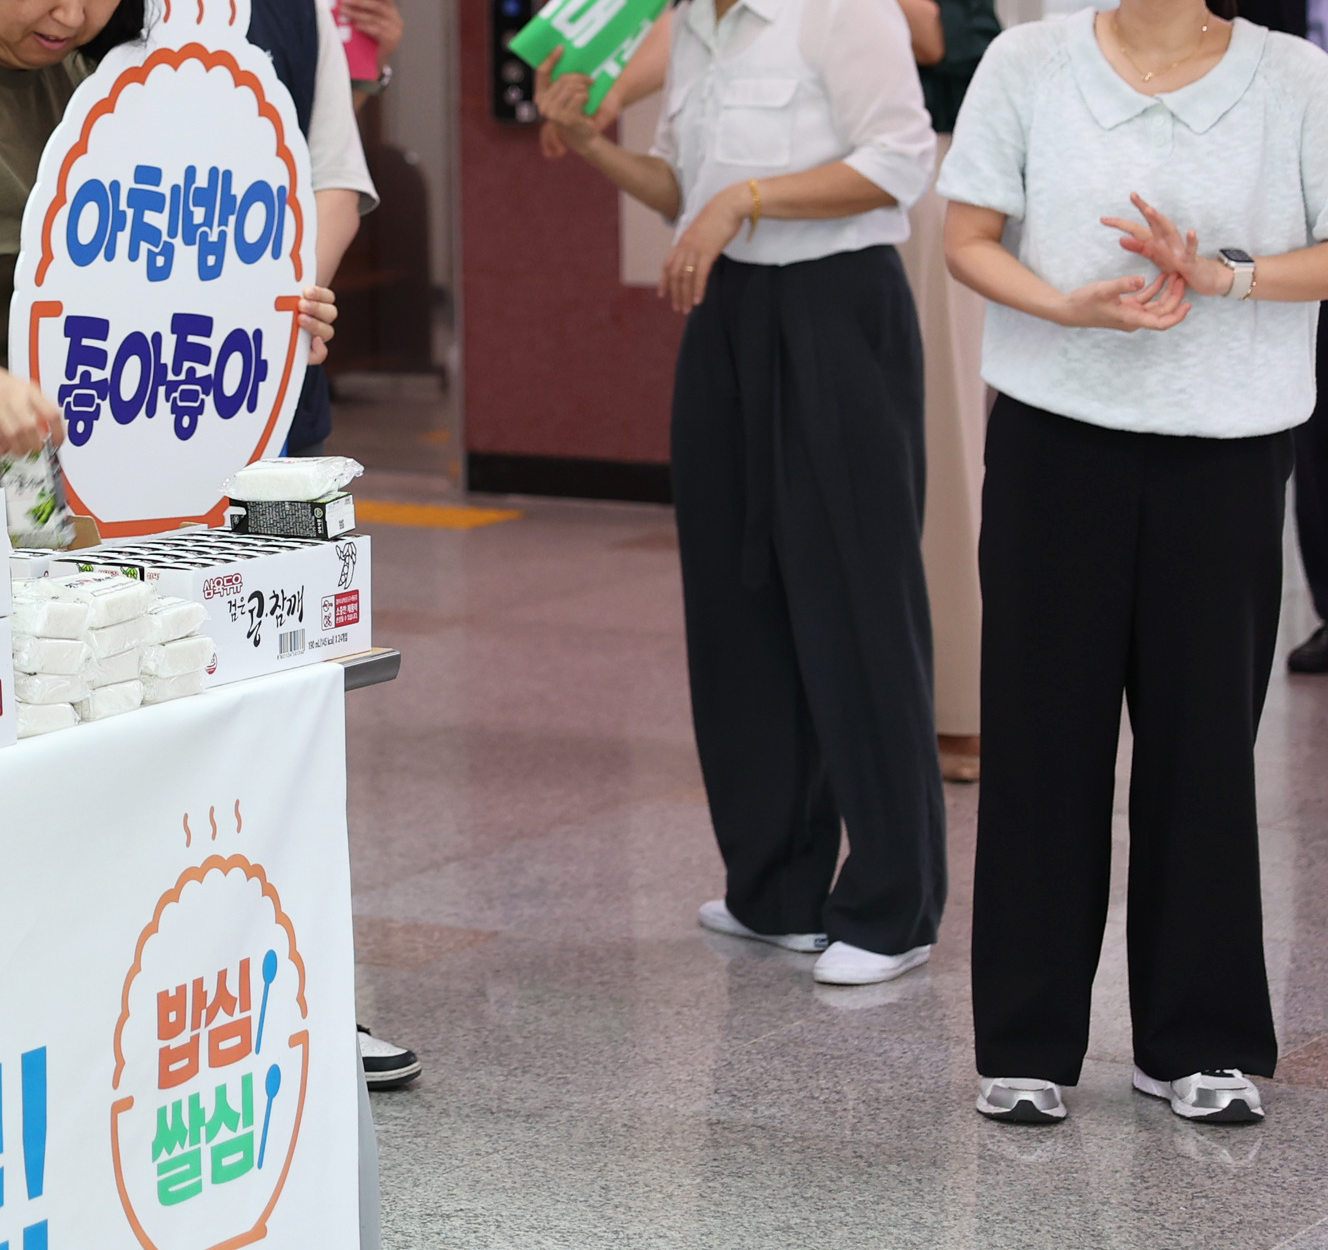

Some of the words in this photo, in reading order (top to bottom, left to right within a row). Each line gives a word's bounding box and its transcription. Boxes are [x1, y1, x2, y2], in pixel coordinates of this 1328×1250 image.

[66, 163, 288, 283] 아침밥이
[58, 312, 269, 448] 좋아좋아
[203, 573, 243, 600] 삼육두유
[227, 595, 246, 622] 검은
[157, 957, 252, 1090] 밥심
[152, 1072, 254, 1206] 쌀심
